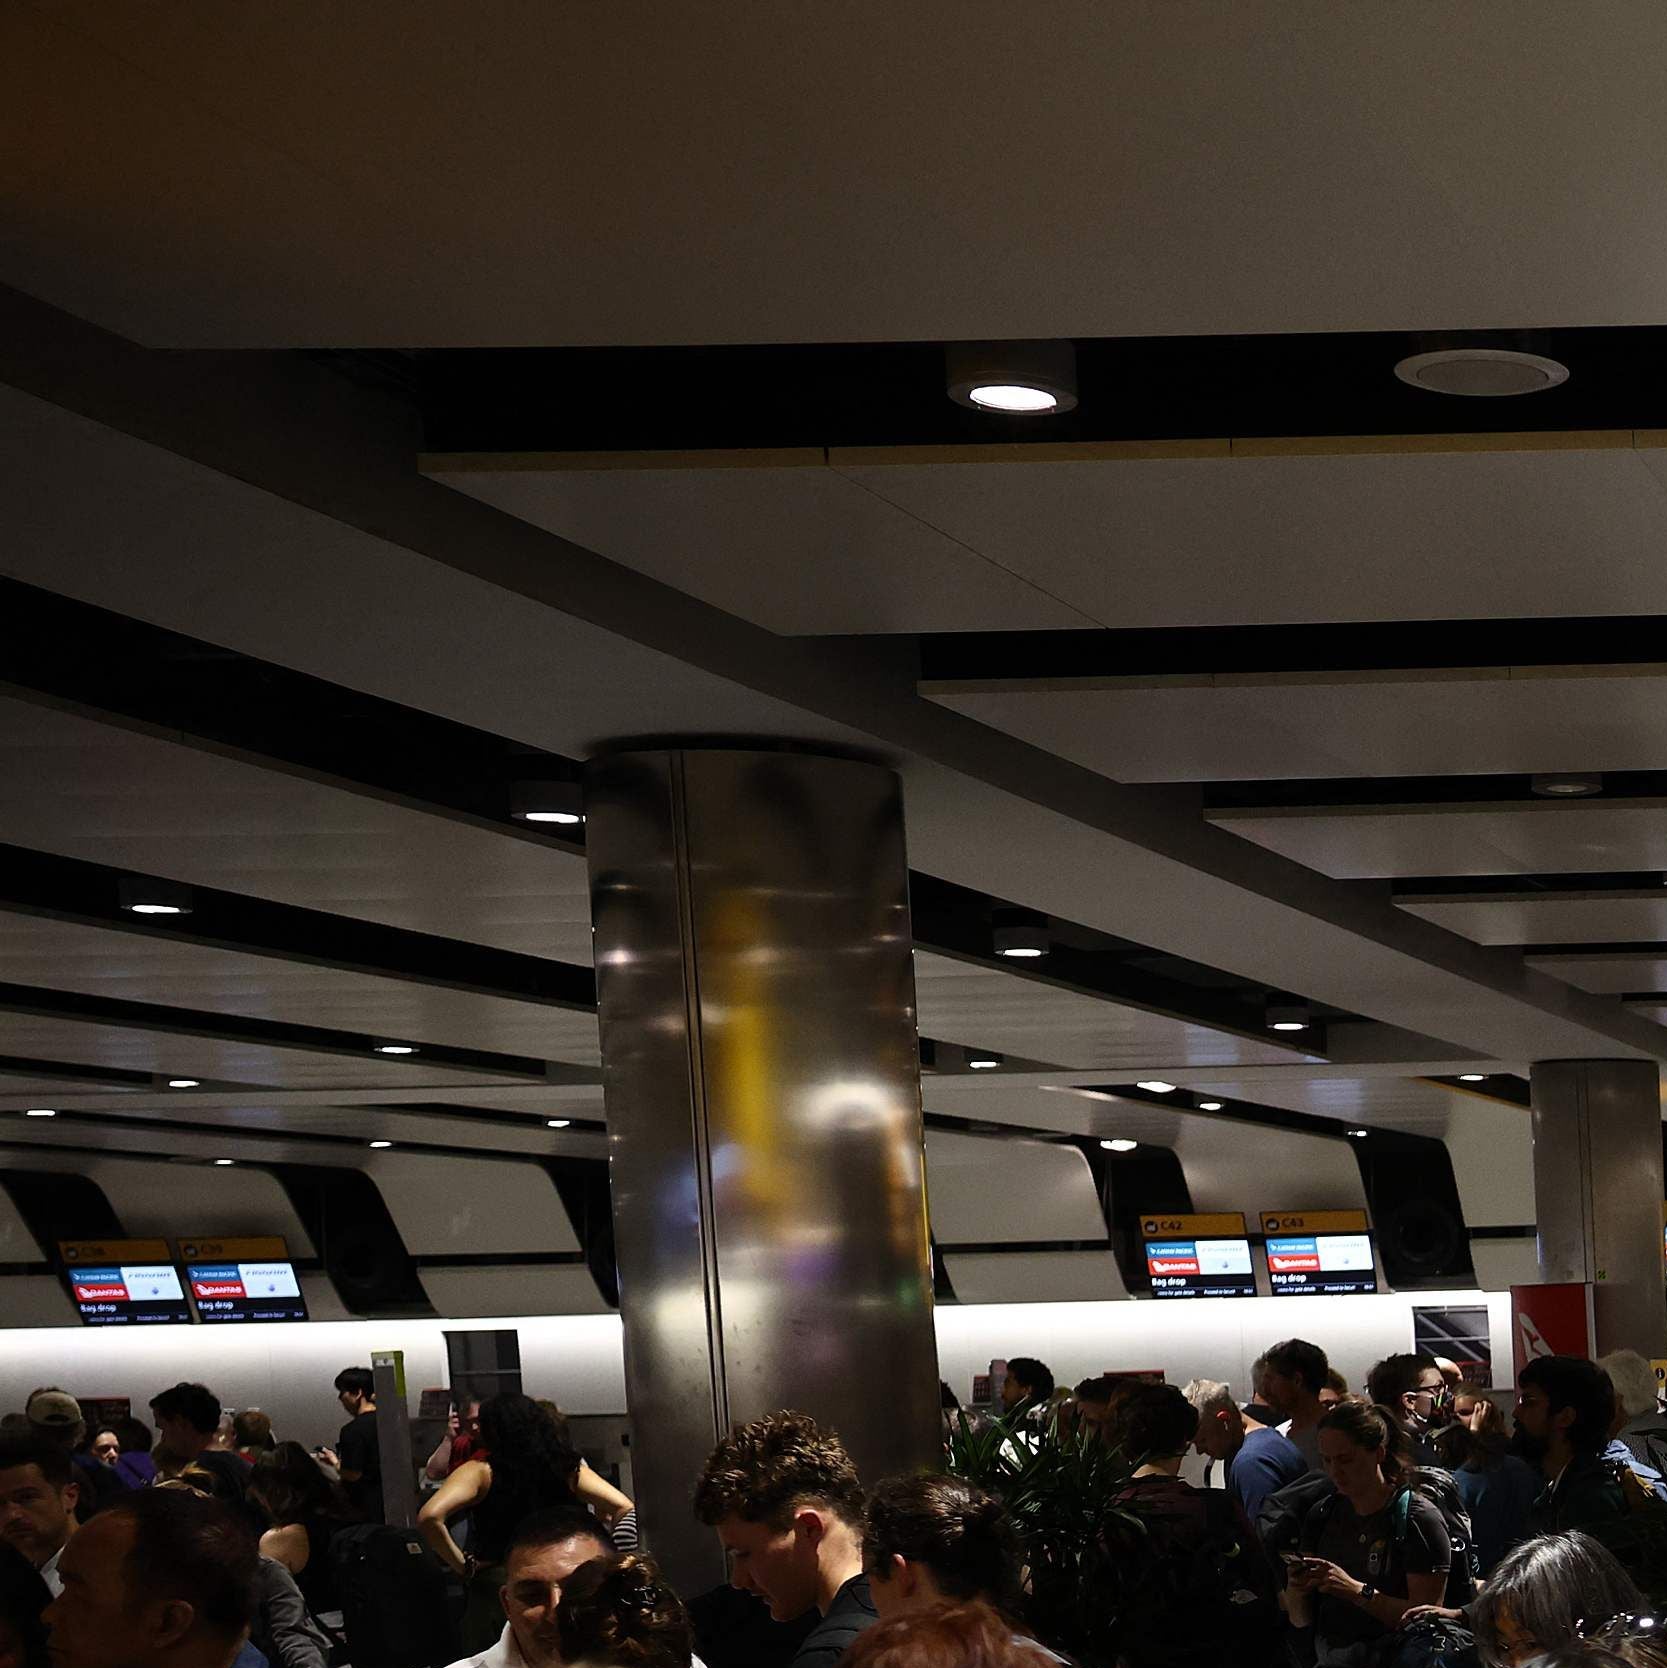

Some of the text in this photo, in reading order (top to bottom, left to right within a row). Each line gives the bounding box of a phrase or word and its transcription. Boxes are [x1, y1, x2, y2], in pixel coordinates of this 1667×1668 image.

[1161, 1221, 1183, 1231] C42
[1282, 1217, 1304, 1228] C43
[1152, 1276, 1187, 1287] Bag drop
[1272, 1273, 1307, 1285] Bag drop
